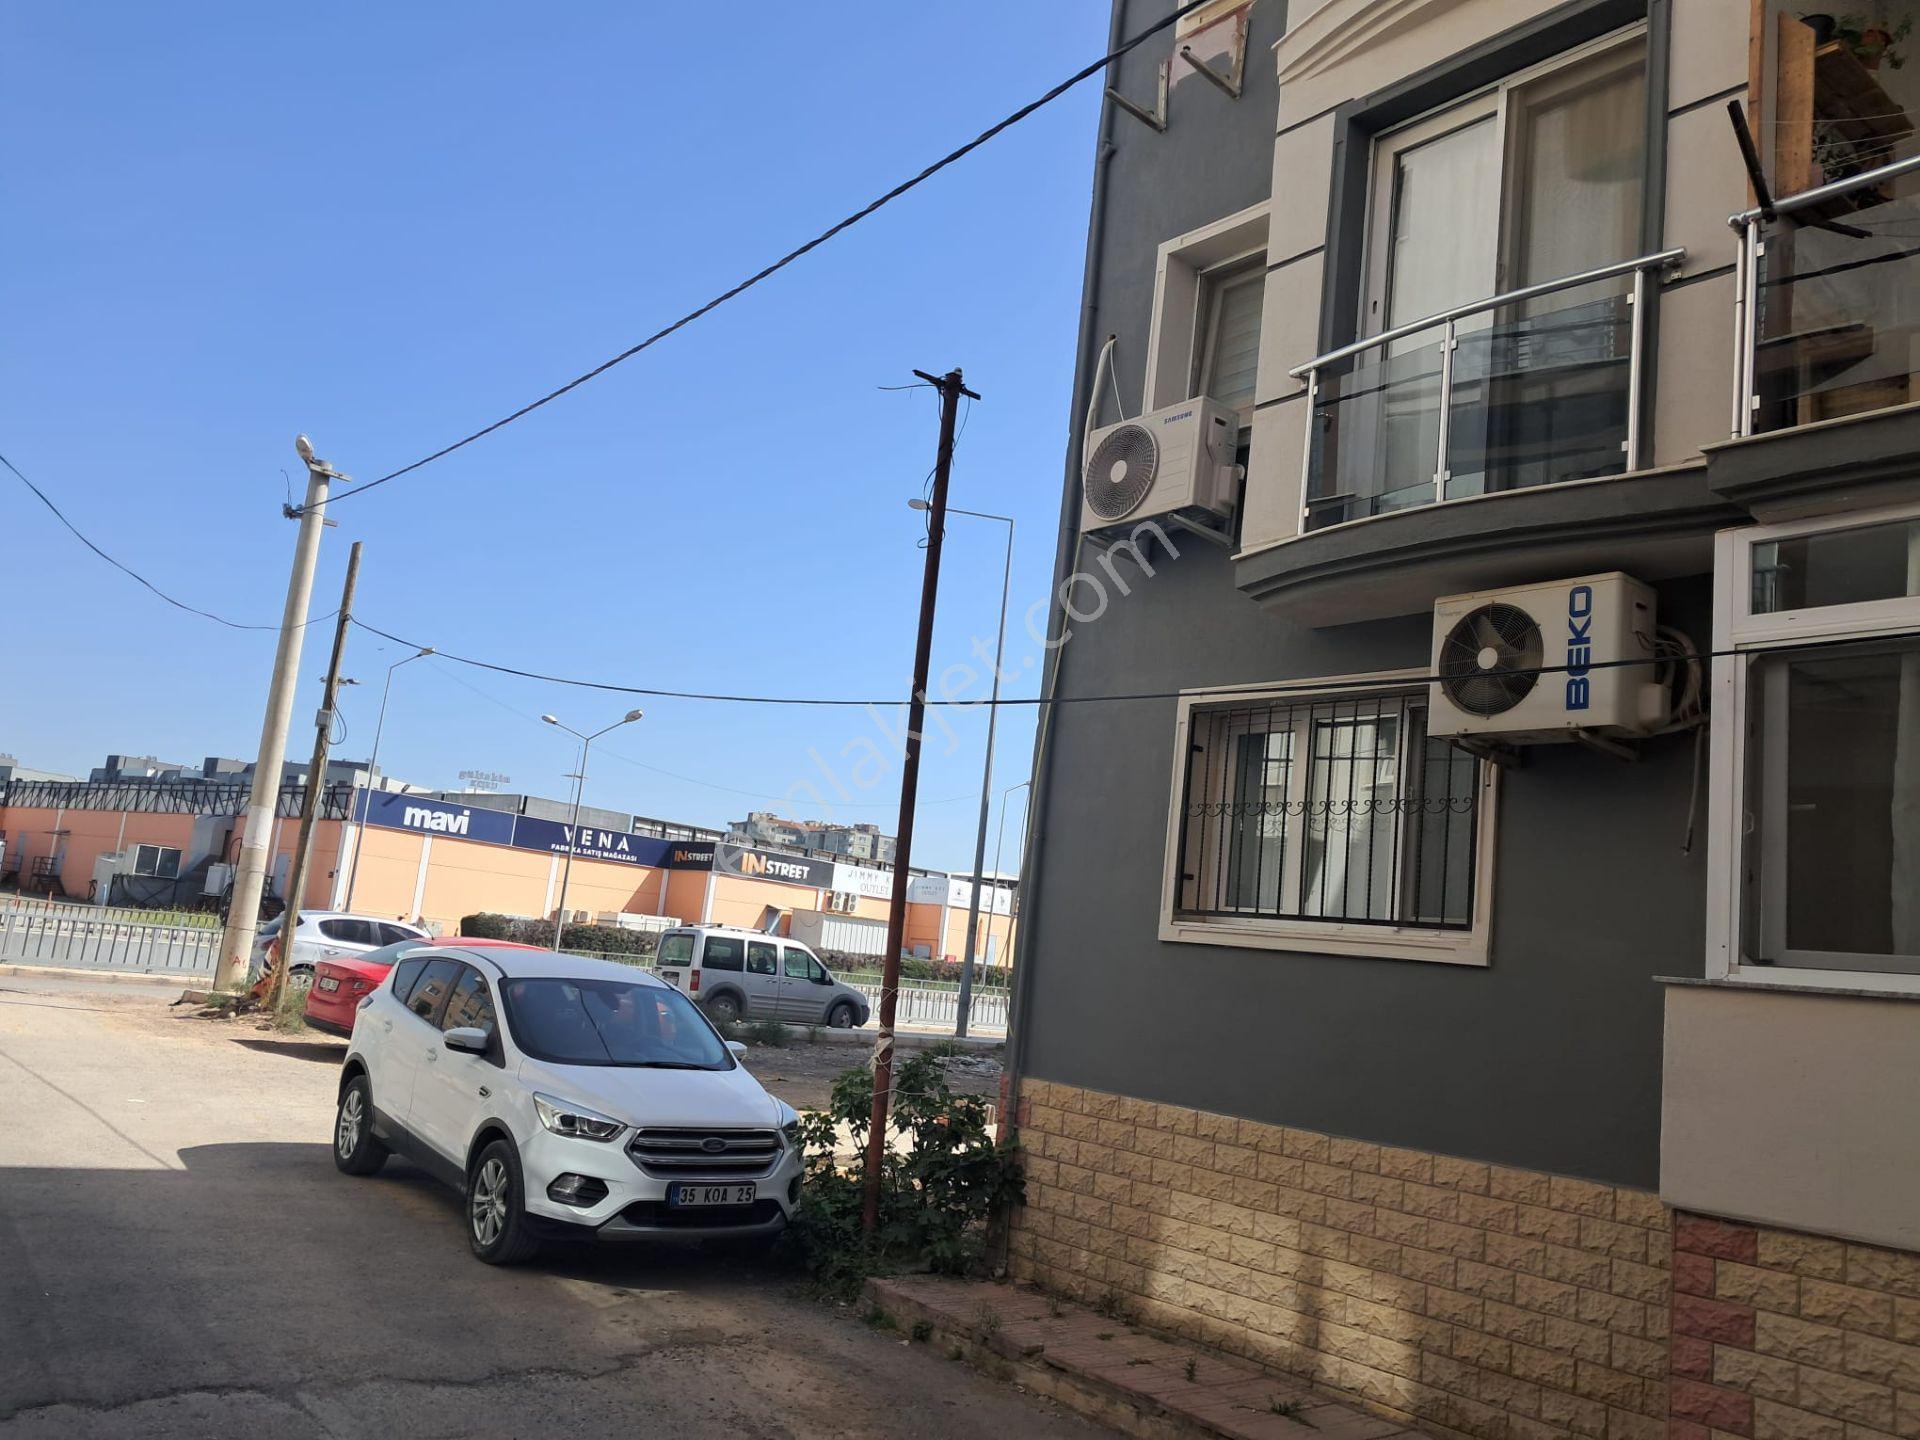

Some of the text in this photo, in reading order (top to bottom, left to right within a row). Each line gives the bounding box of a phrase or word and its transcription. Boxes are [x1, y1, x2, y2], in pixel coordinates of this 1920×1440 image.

[1164, 410, 1192, 424] SAMSUNG
[1566, 585, 1592, 711] BEKO
[403, 806, 470, 835] mavi
[550, 843, 582, 854] FABRKA
[563, 826, 630, 852] VENA
[680, 1186, 753, 1204] 35 KOA 25
